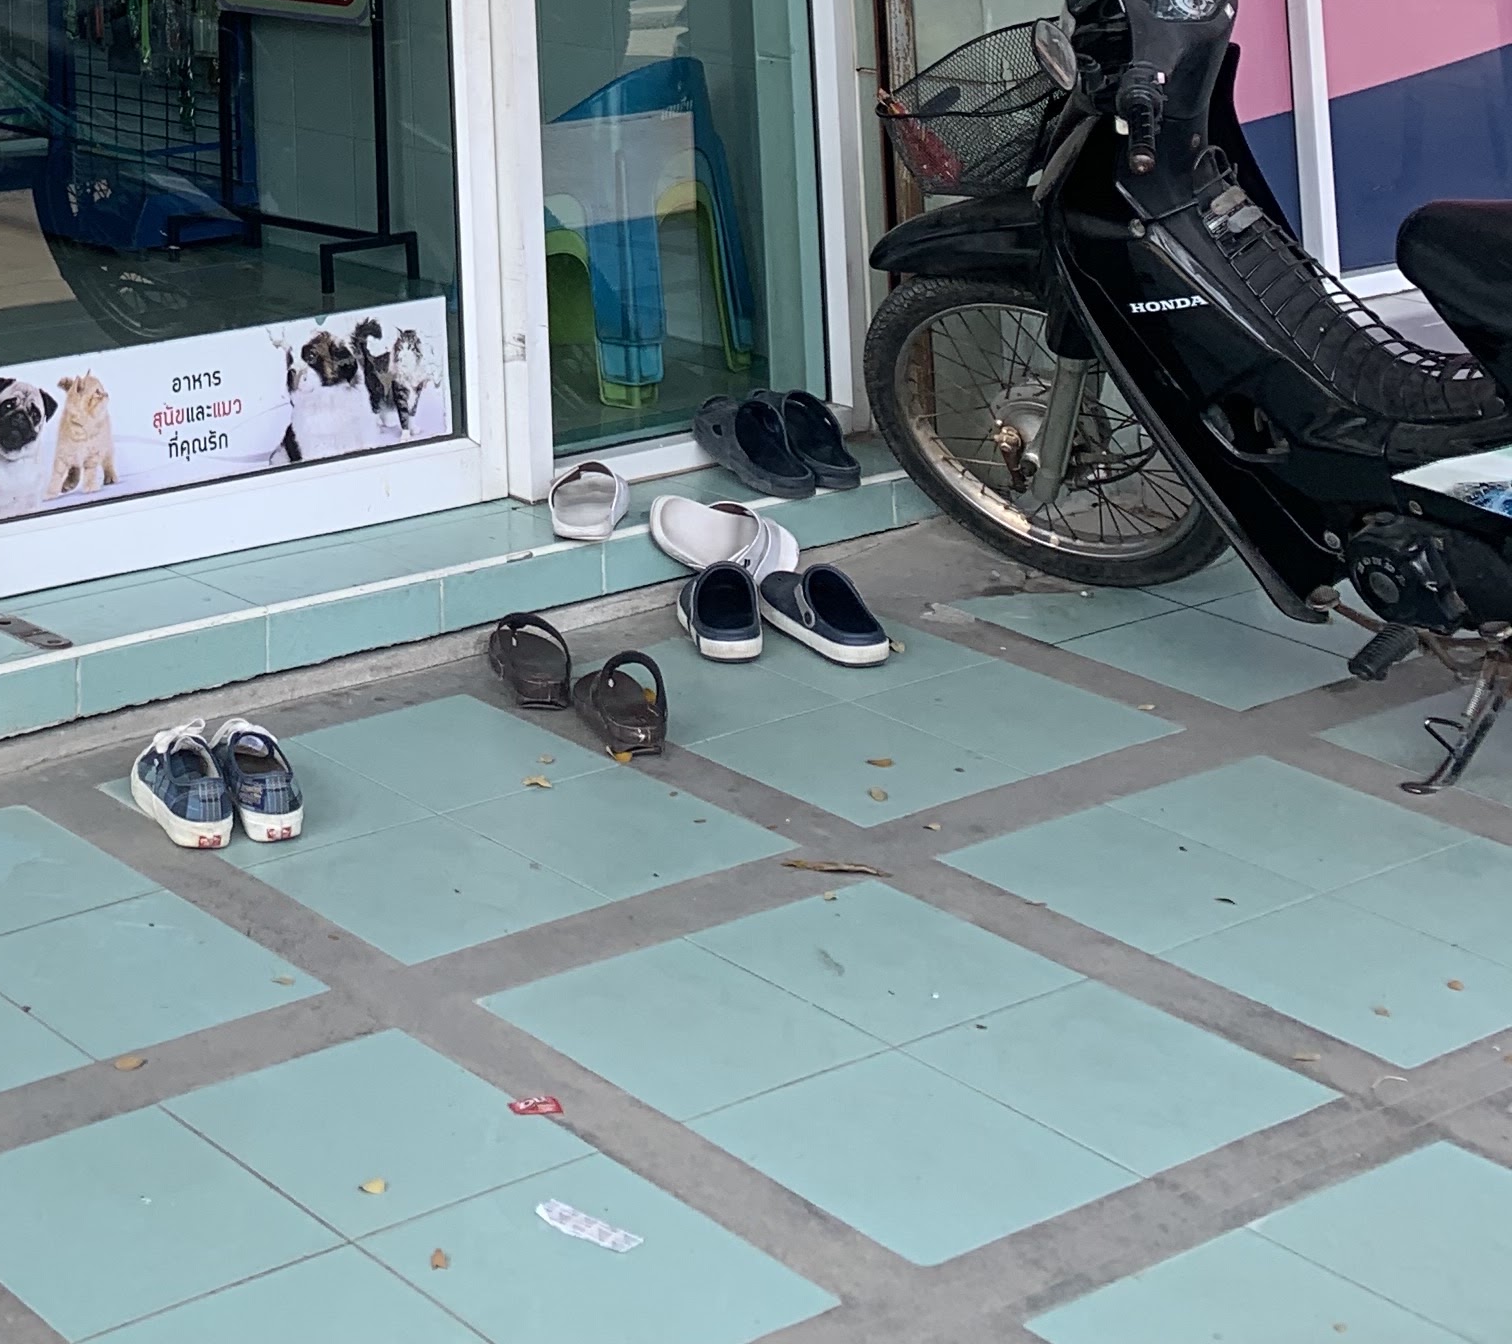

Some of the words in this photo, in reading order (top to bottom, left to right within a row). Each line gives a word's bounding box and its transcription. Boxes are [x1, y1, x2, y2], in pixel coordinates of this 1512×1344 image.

[1129, 295, 1209, 314] HONDA
[172, 370, 221, 392] อาหาร
[167, 430, 229, 461] ที่คุณรัก
